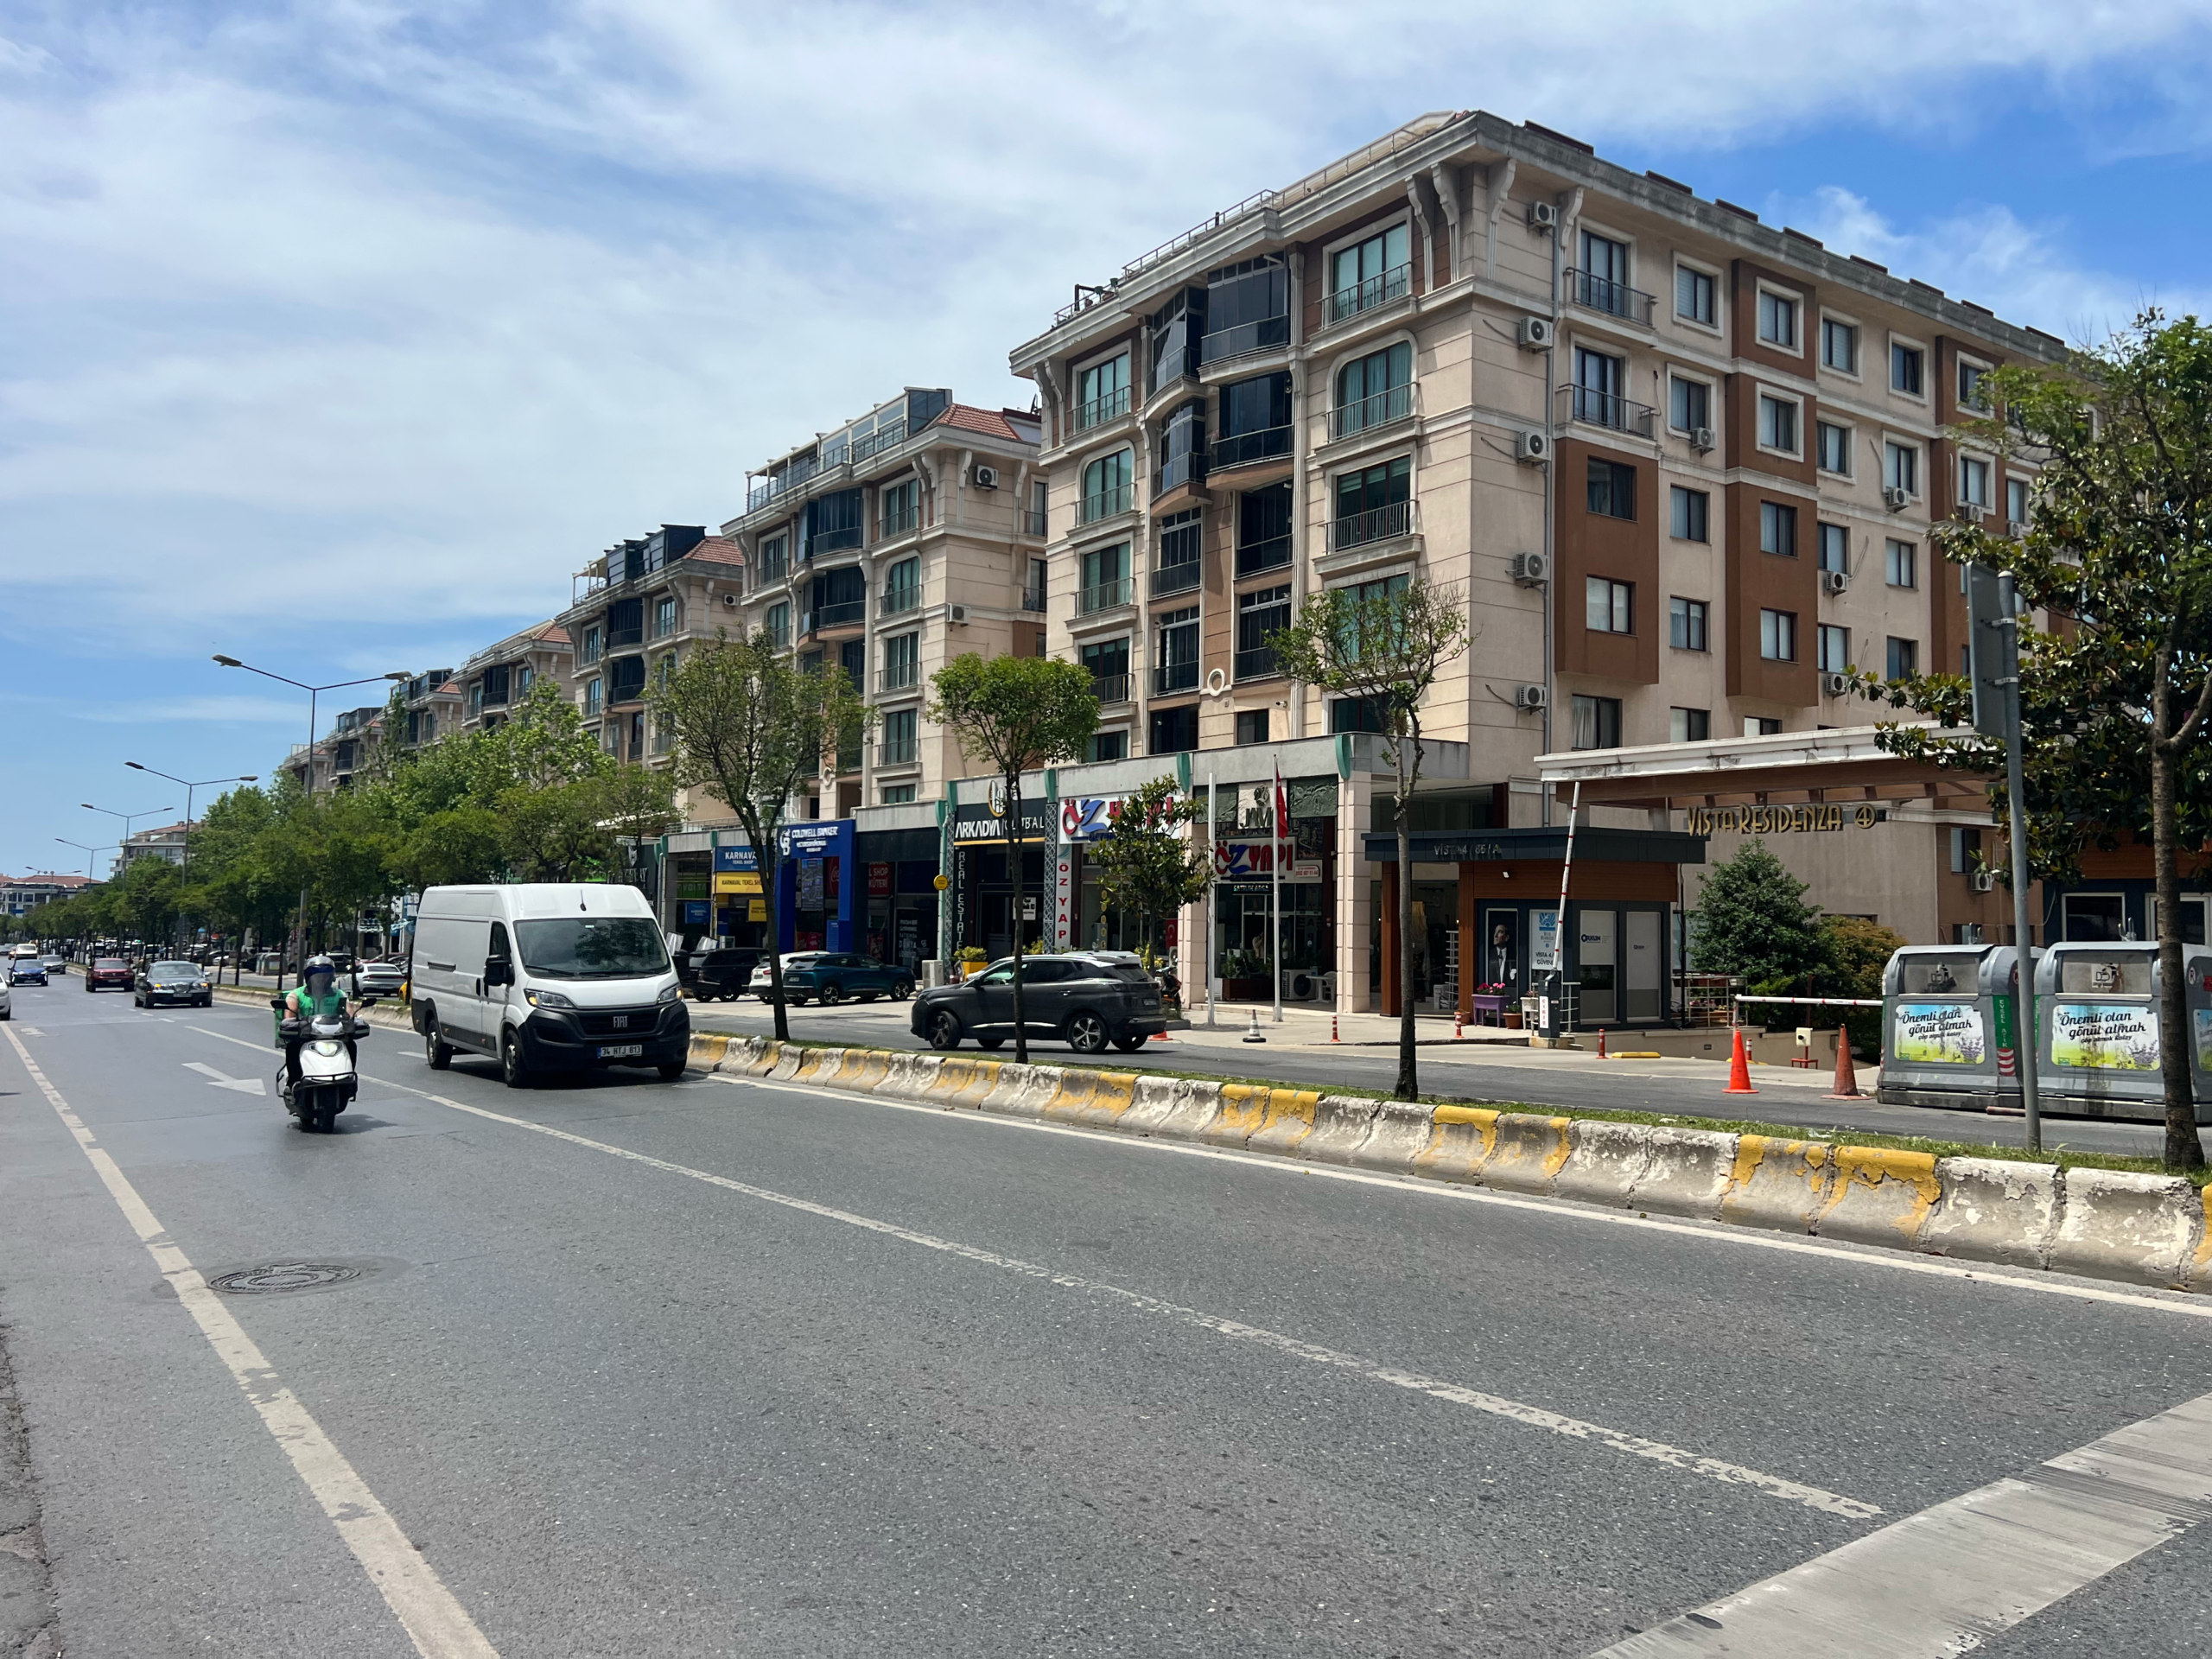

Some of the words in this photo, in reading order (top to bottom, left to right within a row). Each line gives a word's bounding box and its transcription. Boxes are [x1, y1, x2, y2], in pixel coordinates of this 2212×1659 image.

[1687, 804, 1735, 836] VISTA
[1738, 802, 1844, 834] RESIDENZA
[955, 819, 1001, 838] ARKADYA
[613, 1015, 628, 1028] FIAT
[1901, 1011, 1937, 1024] Önemli
[2060, 1012, 2102, 1027] Önemli
[2105, 1012, 2133, 1022] olan
[2069, 1025, 2101, 1040] gönül
